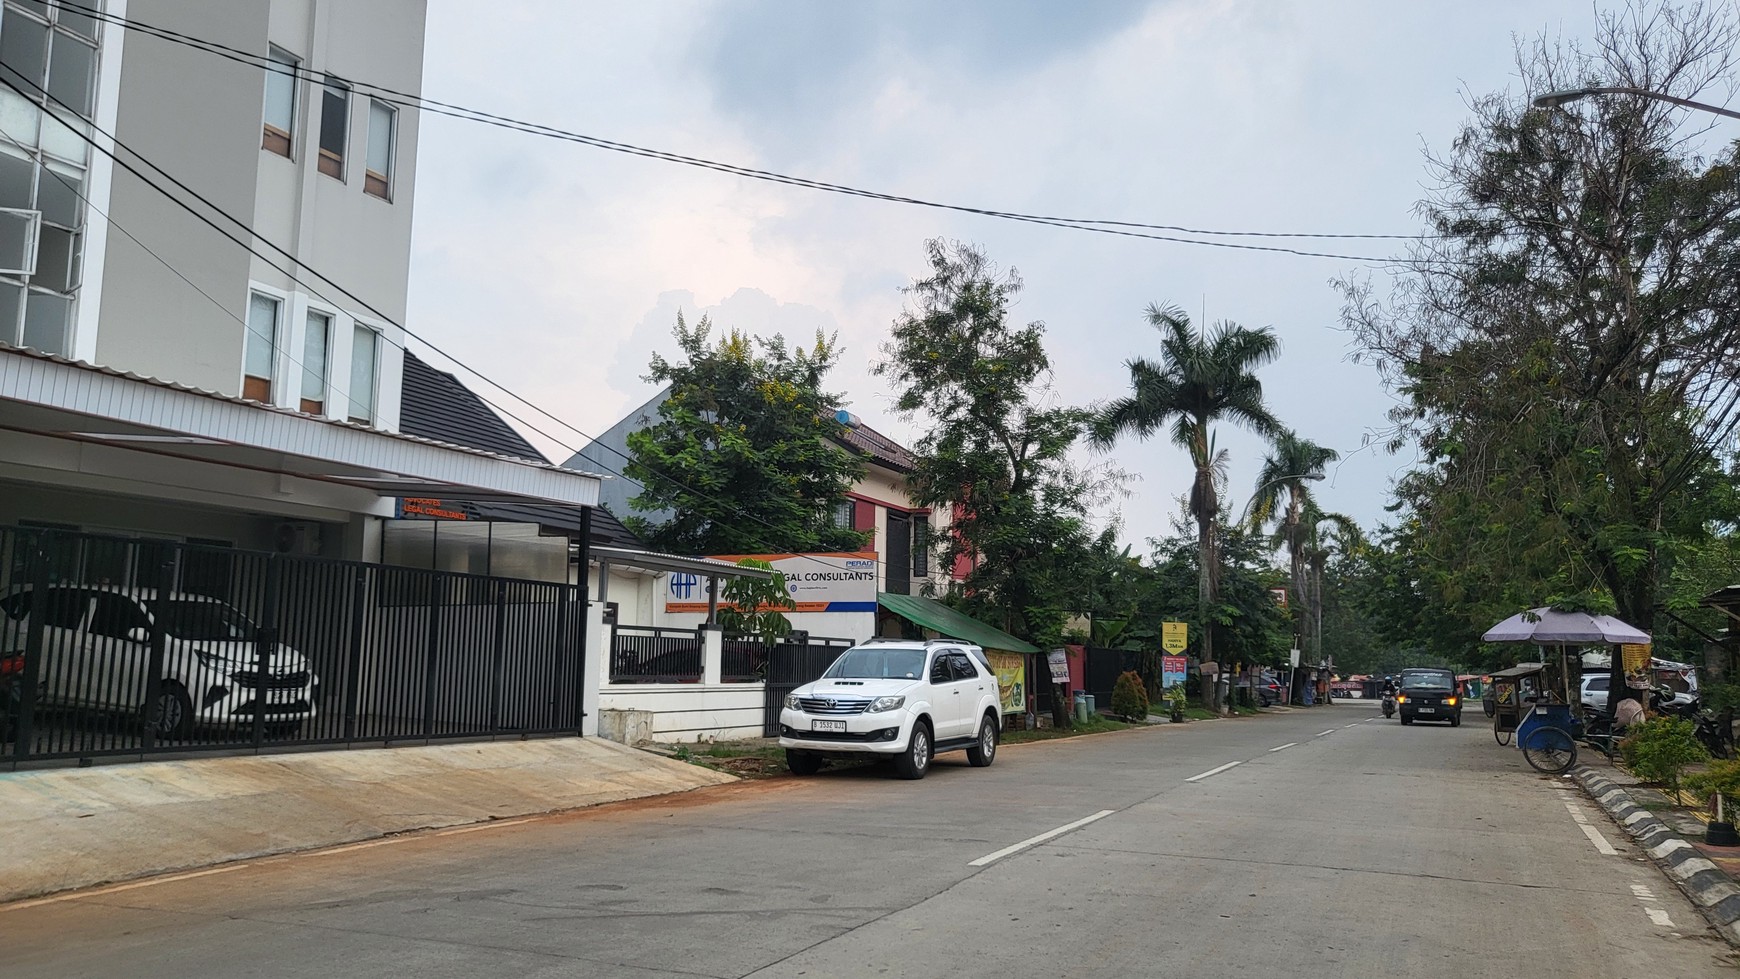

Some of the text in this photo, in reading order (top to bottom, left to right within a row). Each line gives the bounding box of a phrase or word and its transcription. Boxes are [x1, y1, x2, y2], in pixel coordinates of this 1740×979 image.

[404, 505, 466, 520] LEGAL CONSULTANTS
[804, 572, 874, 581] CONSULTANTS
